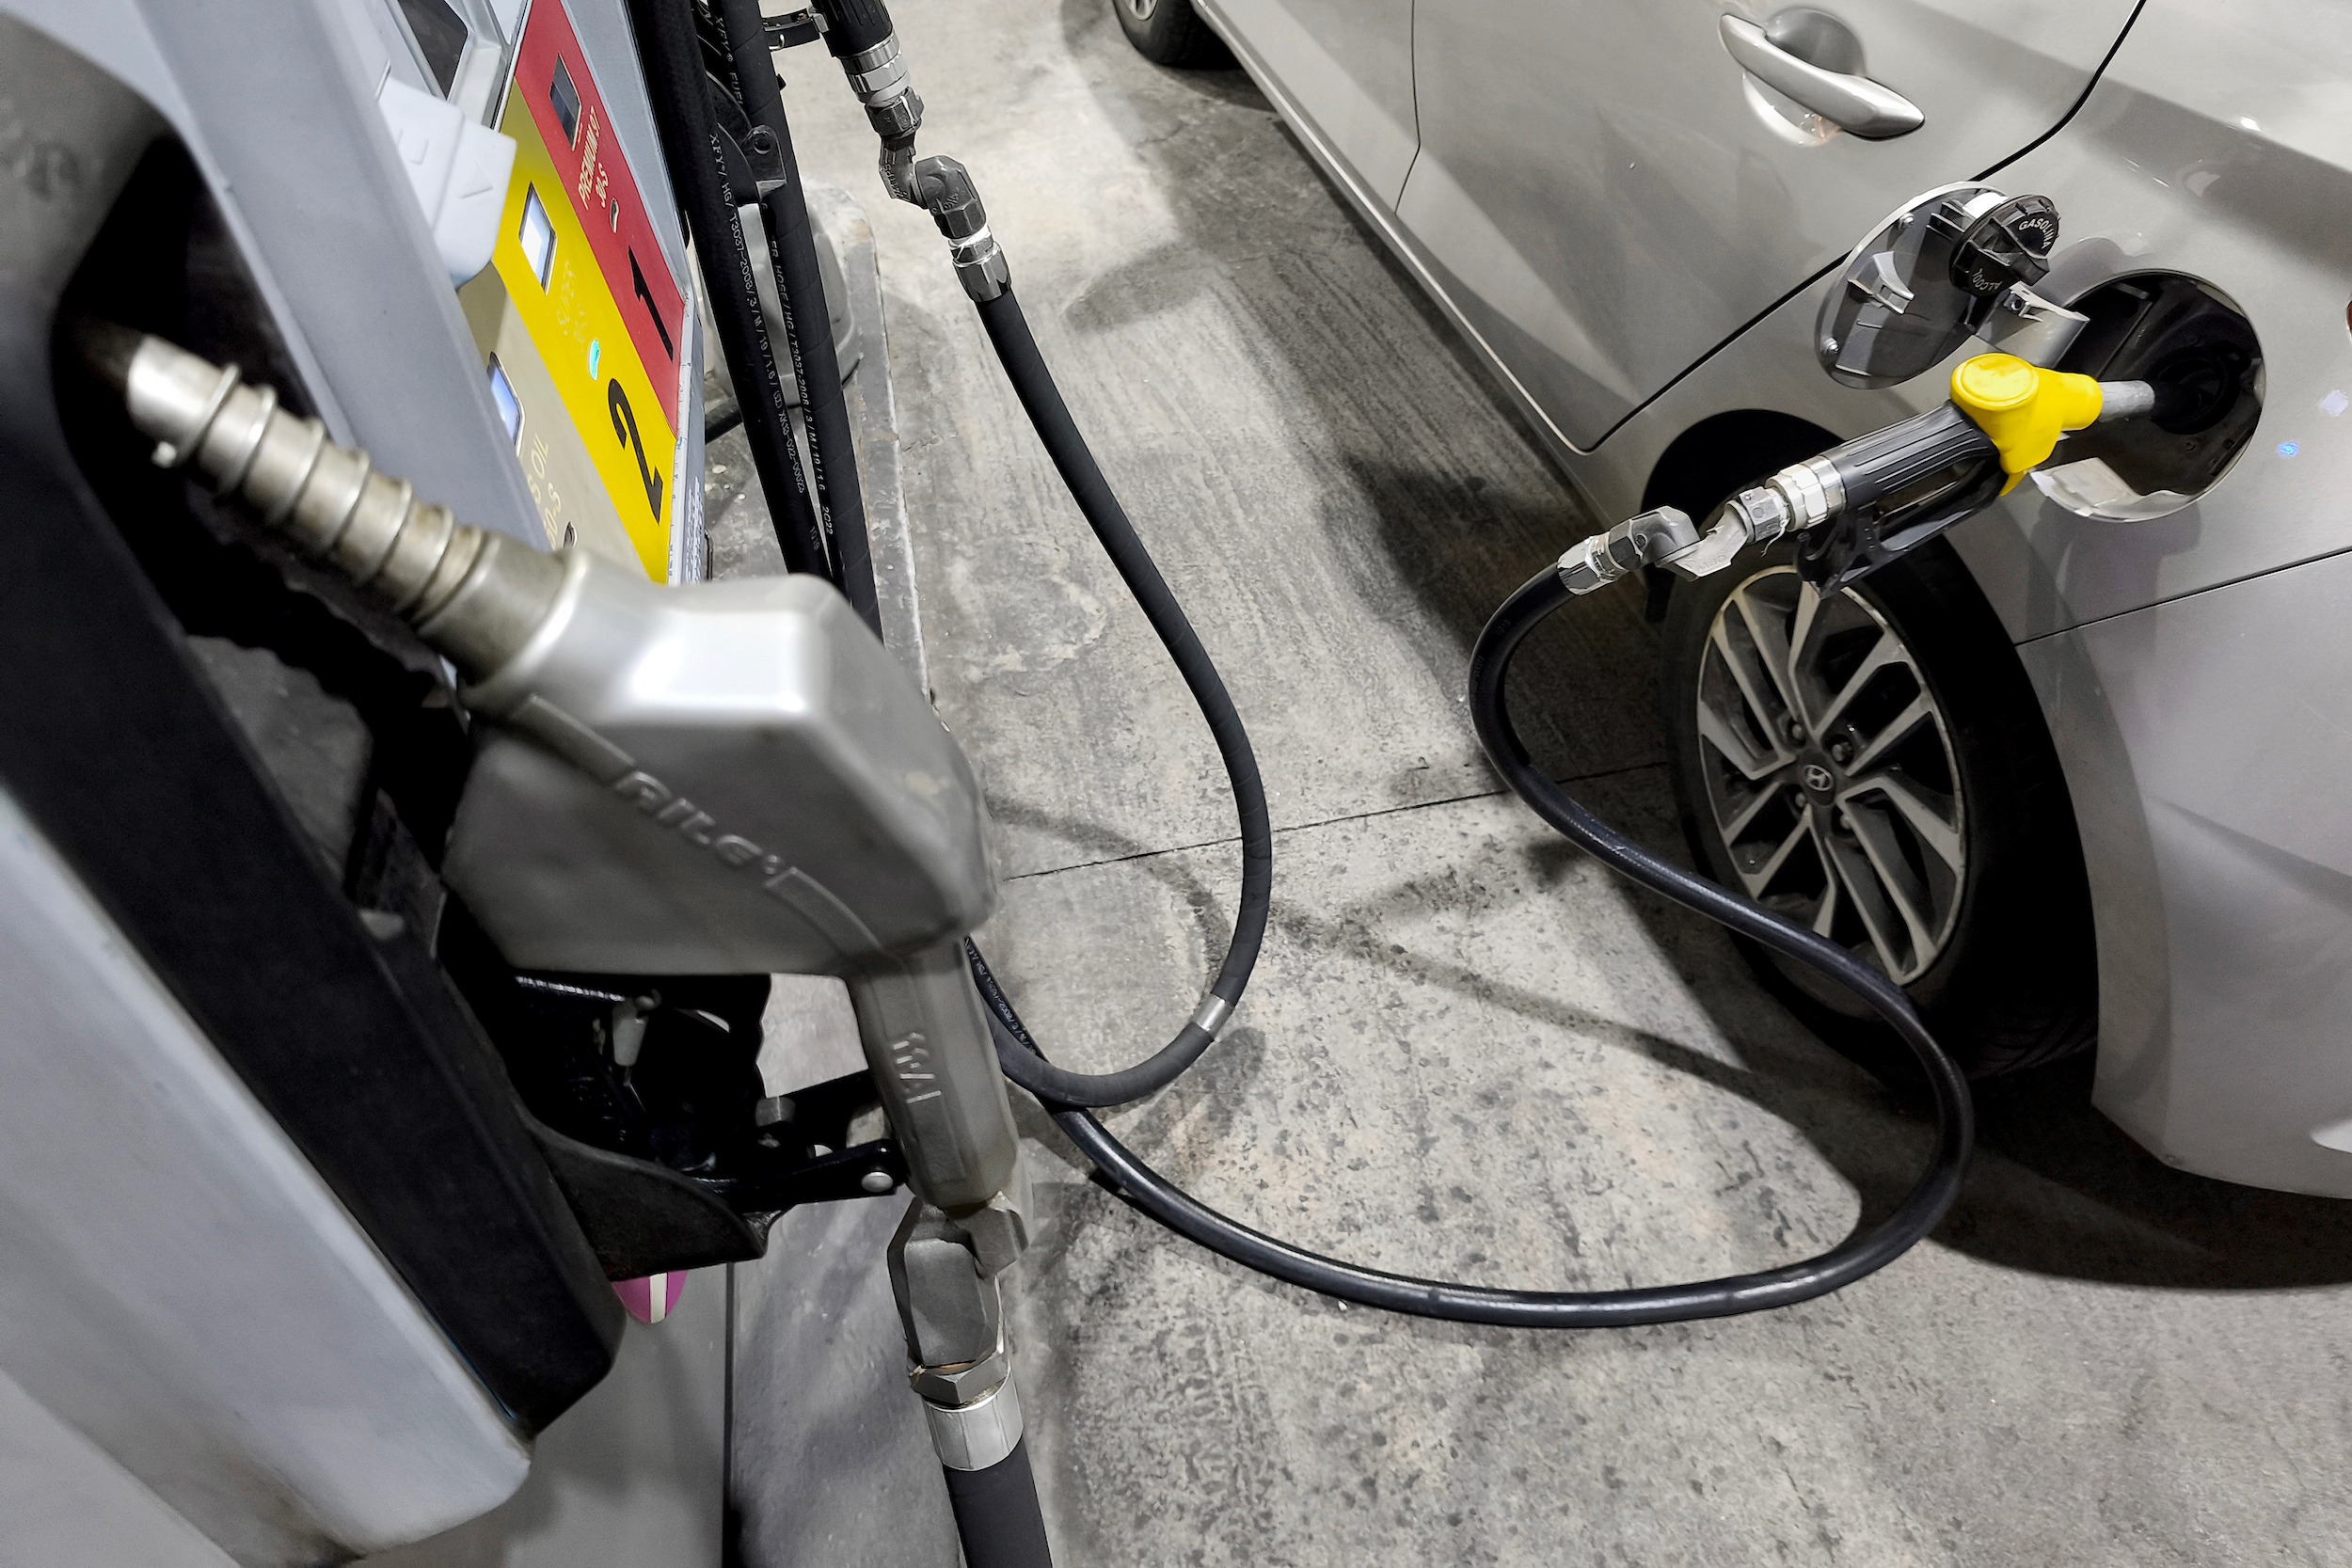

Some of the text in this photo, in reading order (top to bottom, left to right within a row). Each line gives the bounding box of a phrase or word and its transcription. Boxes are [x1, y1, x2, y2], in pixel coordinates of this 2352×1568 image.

[579, 123, 598, 211] PREMIUM
[590, 104, 600, 138] 97
[2018, 217, 2054, 249] GASOLINA
[628, 245, 674, 363] 1
[1972, 267, 2003, 292] ALCOOL
[531, 433, 549, 481] OIL
[608, 378, 663, 527] 2
